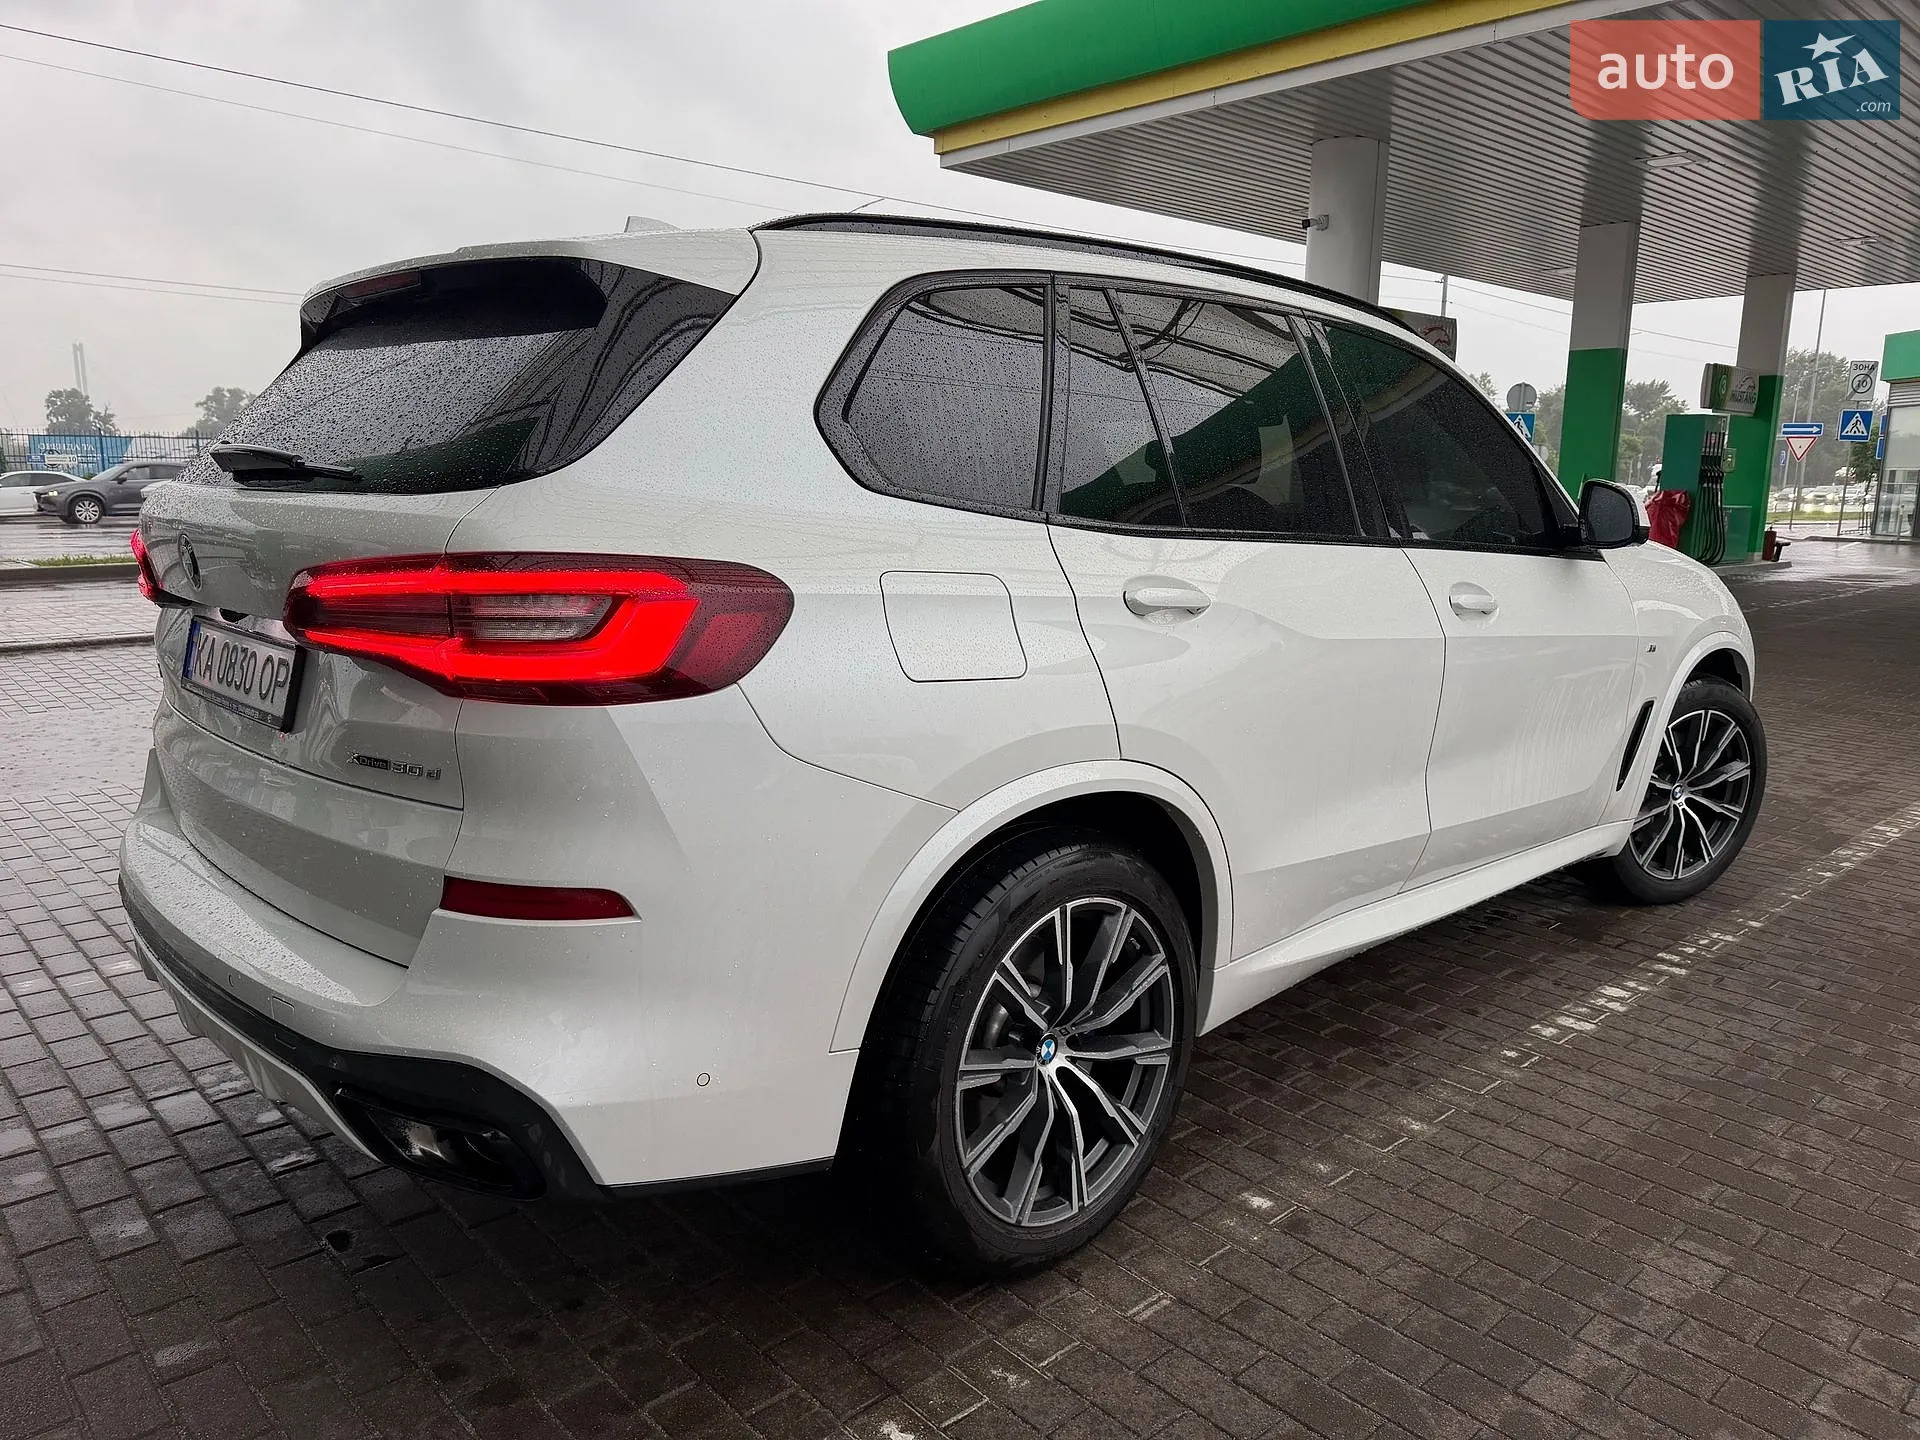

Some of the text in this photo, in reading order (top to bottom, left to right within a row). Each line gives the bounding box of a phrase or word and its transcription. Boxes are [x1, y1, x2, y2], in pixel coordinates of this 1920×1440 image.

[1852, 363, 1876, 371] ЗОНА
[194, 631, 216, 681] KA
[217, 641, 258, 695] 0830
[259, 654, 290, 704] OP
